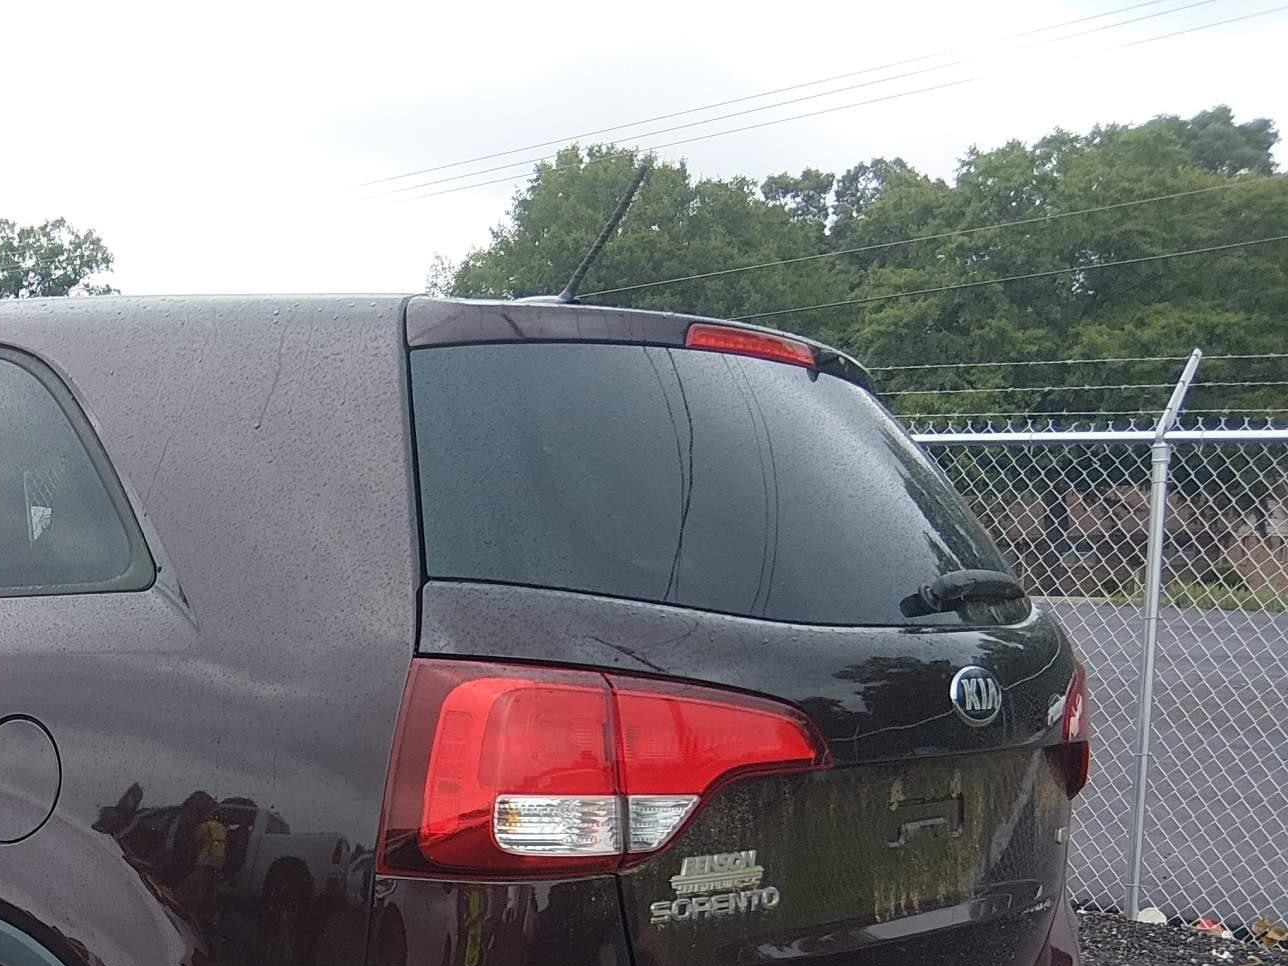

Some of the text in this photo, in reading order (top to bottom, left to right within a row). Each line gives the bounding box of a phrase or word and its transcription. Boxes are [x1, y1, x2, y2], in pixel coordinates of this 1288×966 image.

[960, 678, 999, 711] KIA
[680, 850, 757, 877] BENSON
[650, 886, 780, 925] SORENTO
